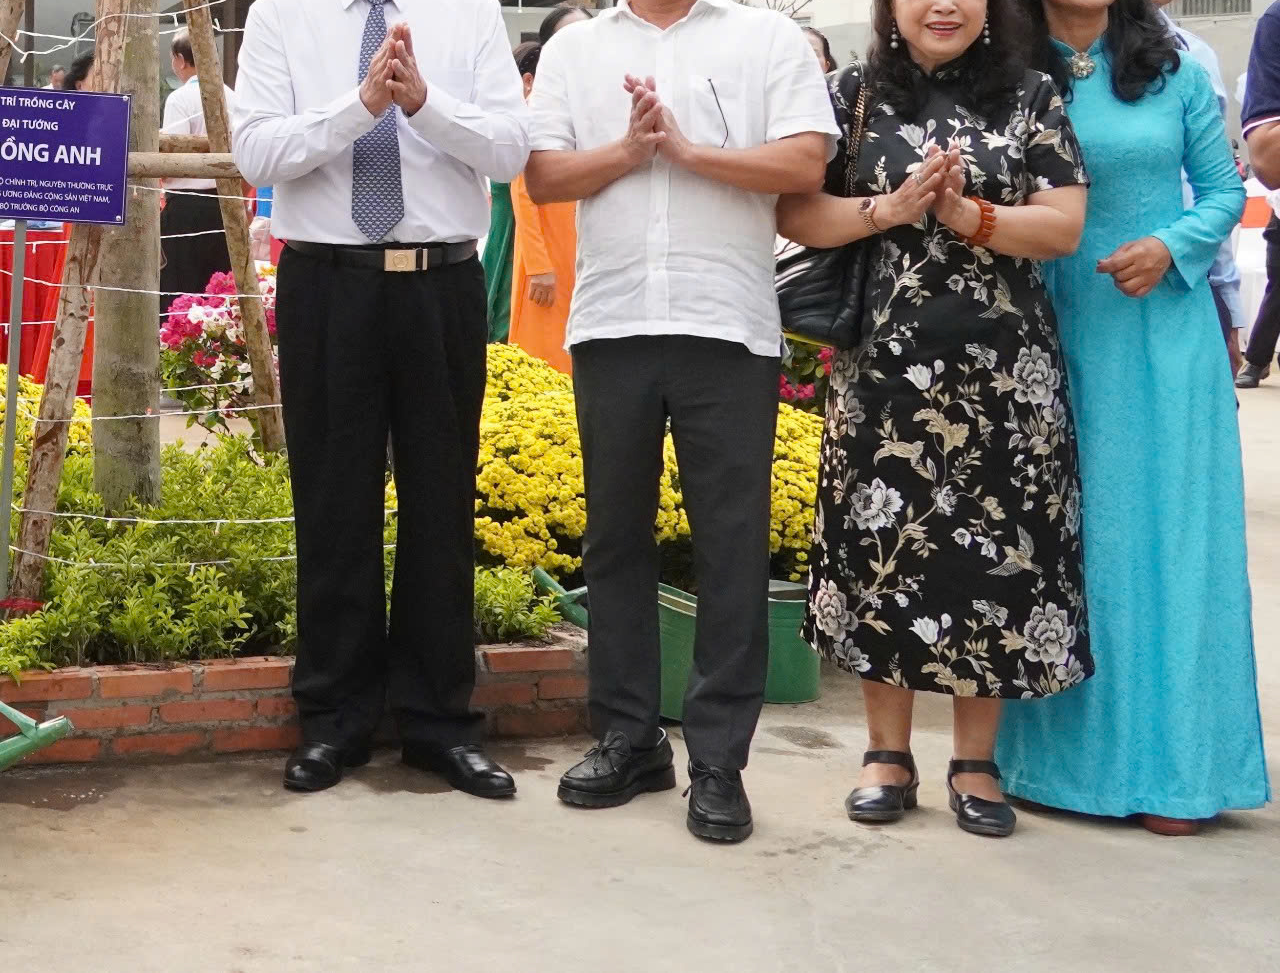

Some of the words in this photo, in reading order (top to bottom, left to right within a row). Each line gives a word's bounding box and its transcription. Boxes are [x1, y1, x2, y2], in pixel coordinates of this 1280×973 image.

[0, 96, 17, 107] TRÍ
[56, 99, 76, 111] CÂY
[2, 118, 20, 131] ĐẠI
[22, 119, 59, 132] TƯỚNG
[53, 145, 102, 166] ANH
[70, 205, 80, 214] AN
